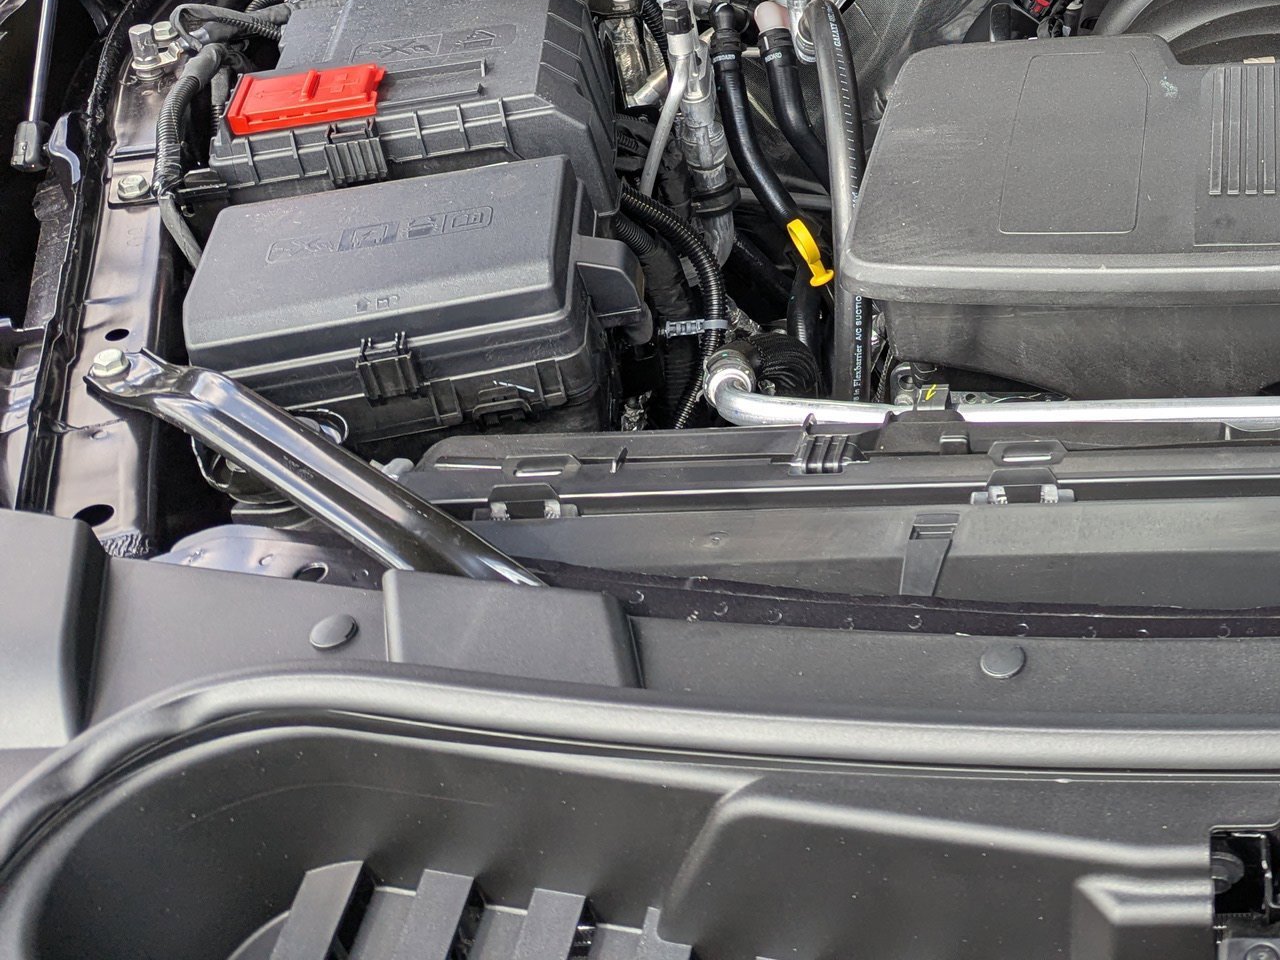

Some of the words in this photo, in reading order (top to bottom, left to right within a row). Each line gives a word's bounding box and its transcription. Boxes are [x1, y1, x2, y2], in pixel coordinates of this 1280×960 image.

[830, 22, 841, 47] GALAXY
[855, 295, 863, 327] SUCTIO
[855, 327, 863, 341] A/C
[854, 344, 863, 387] Flexbarrier
